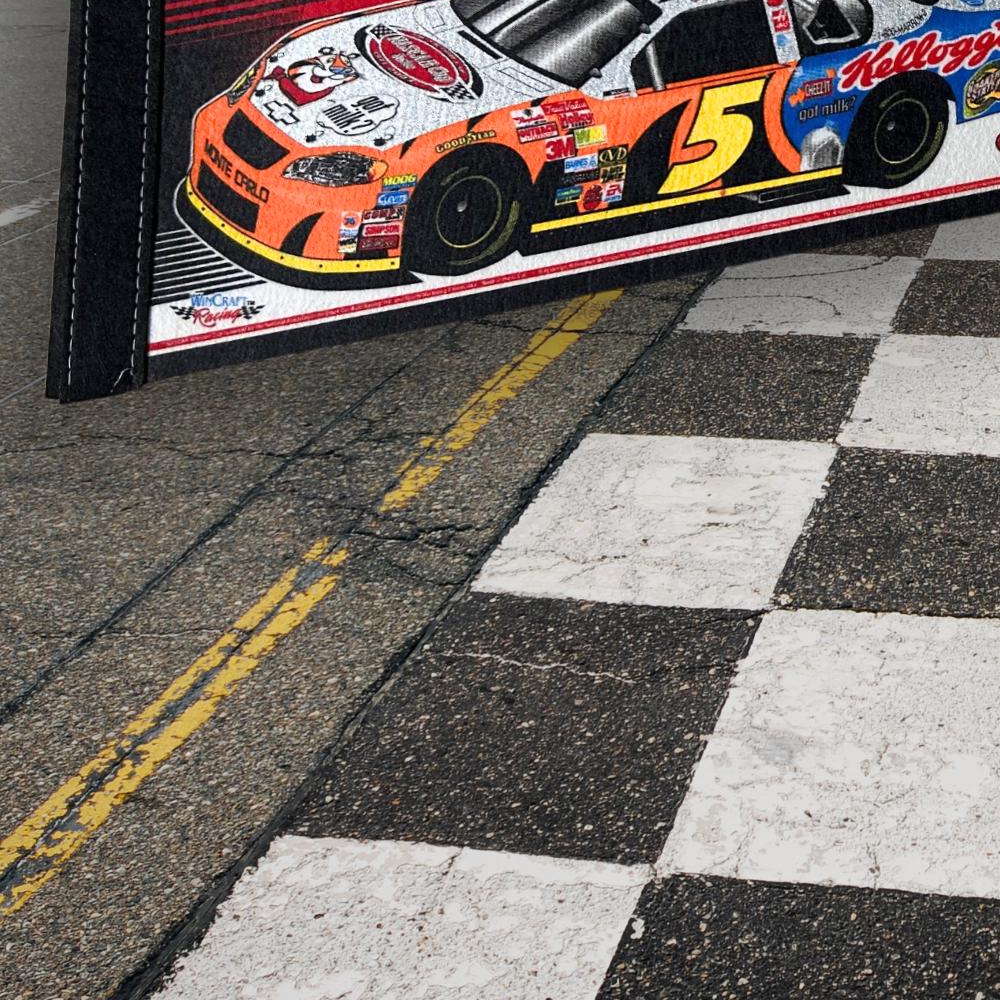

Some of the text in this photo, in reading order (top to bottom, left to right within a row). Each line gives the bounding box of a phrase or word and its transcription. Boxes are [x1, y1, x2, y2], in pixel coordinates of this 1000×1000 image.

[351, 96, 395, 114] got
[799, 104, 819, 120] got
[322, 103, 376, 134] milk?
[656, 77, 759, 196] 5
[545, 136, 576, 161] 3M
[192, 307, 243, 328] Racing
